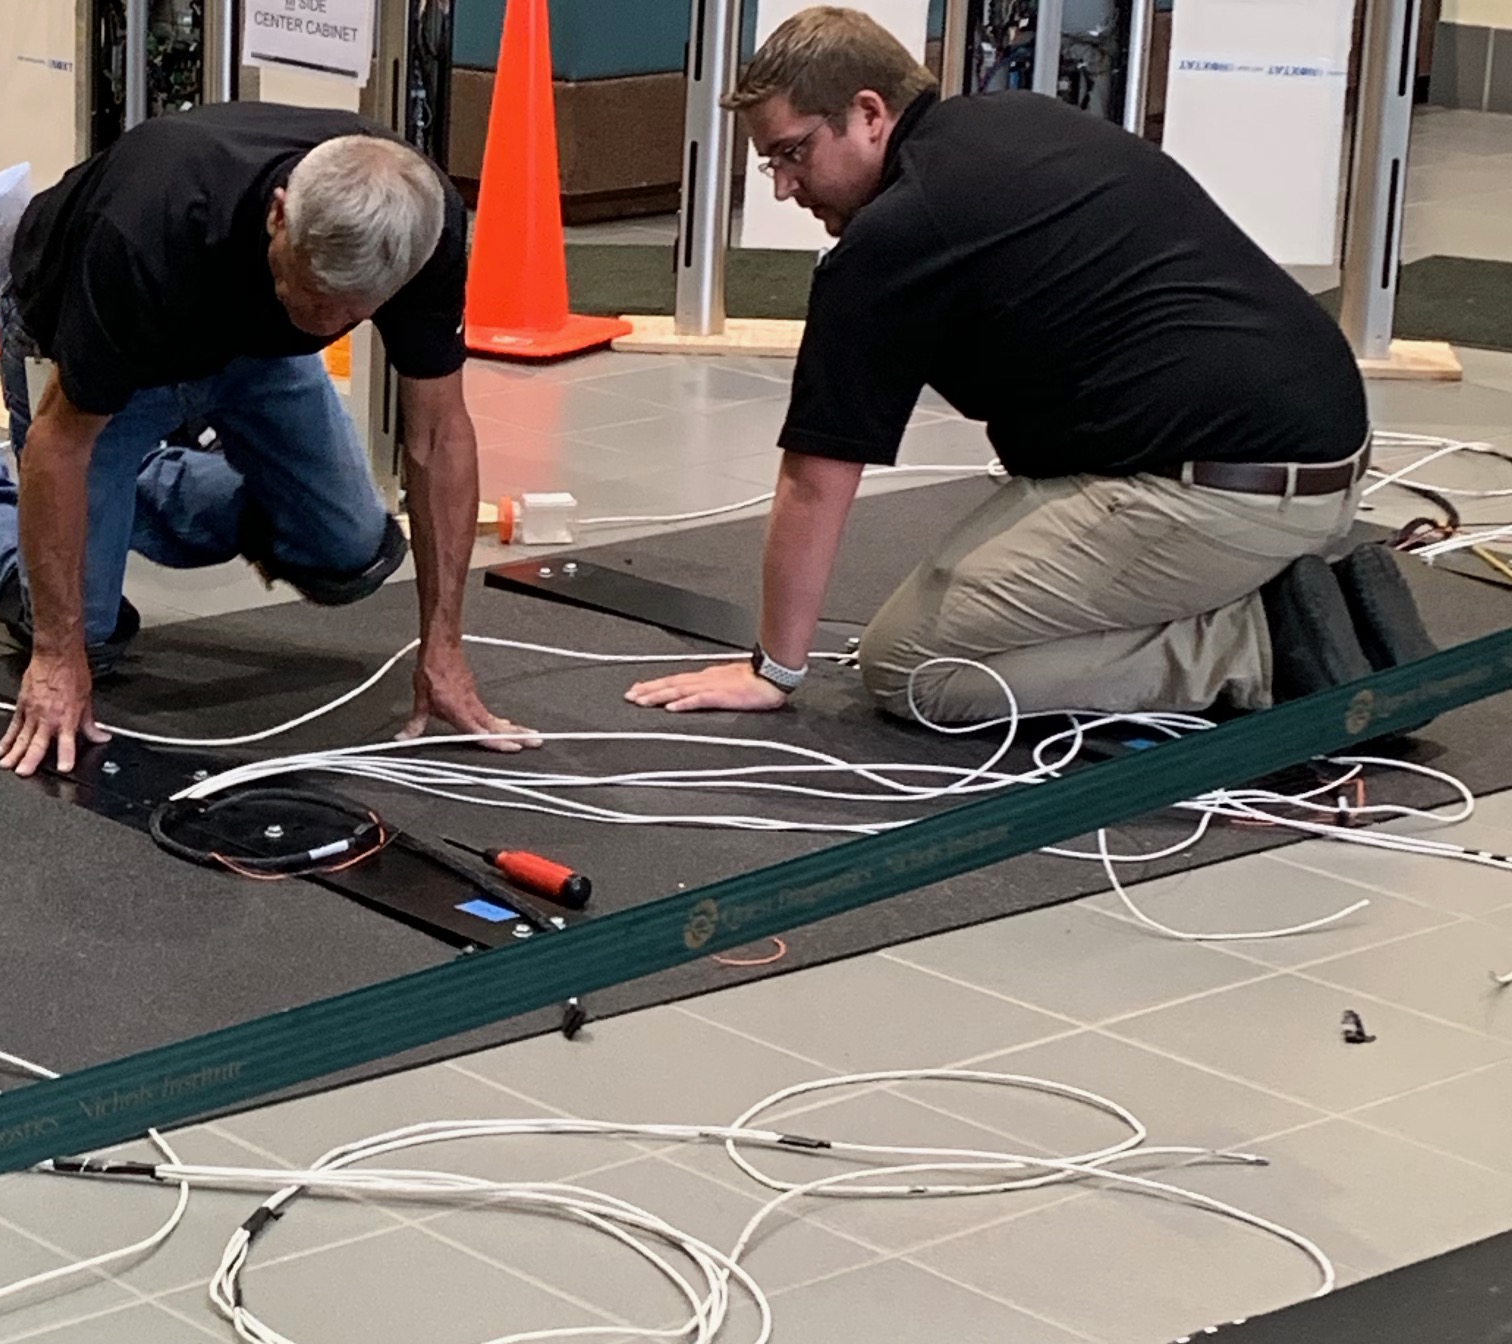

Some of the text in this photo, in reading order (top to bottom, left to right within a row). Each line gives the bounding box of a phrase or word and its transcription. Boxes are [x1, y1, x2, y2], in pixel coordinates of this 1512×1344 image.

[254, 10, 358, 42] CENTER CABINET
[77, 1082, 154, 1120] Nichols
[161, 1060, 246, 1099] Institute
